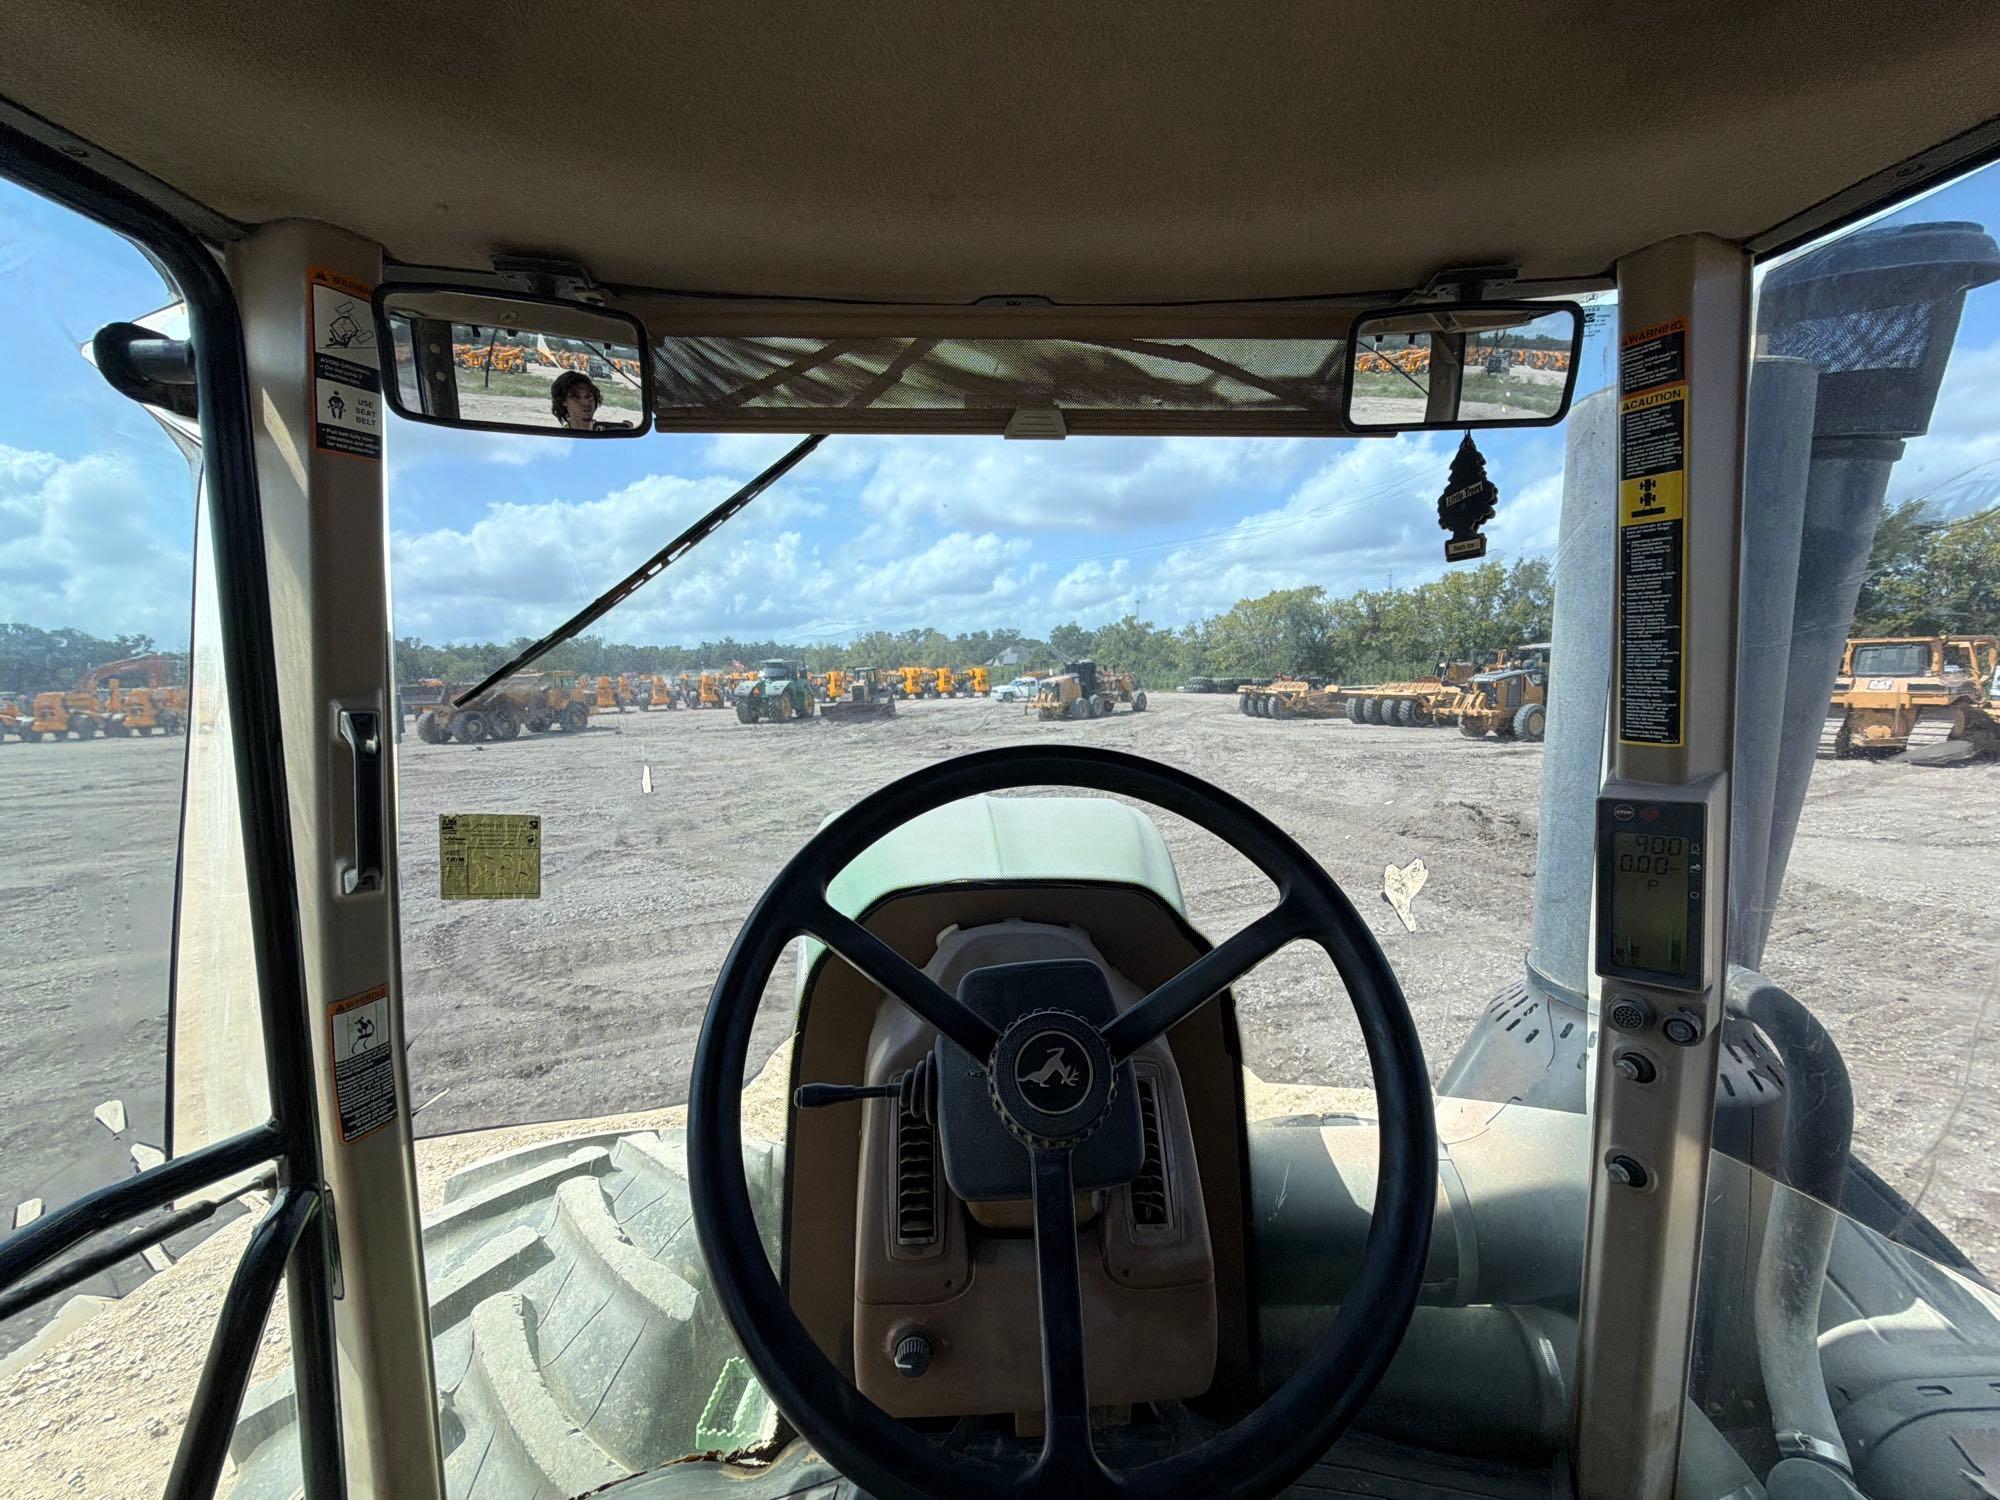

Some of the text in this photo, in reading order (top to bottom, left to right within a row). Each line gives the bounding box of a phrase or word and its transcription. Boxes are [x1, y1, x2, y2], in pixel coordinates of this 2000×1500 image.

[1629, 320, 1684, 344] WARNING
[357, 399, 375, 409] USE
[1630, 389, 1681, 410] CAUTION
[355, 407, 376, 418] SEAT
[355, 416, 376, 426] BELT
[1447, 484, 1482, 506] Little Trees
[1636, 836, 1682, 856] 900
